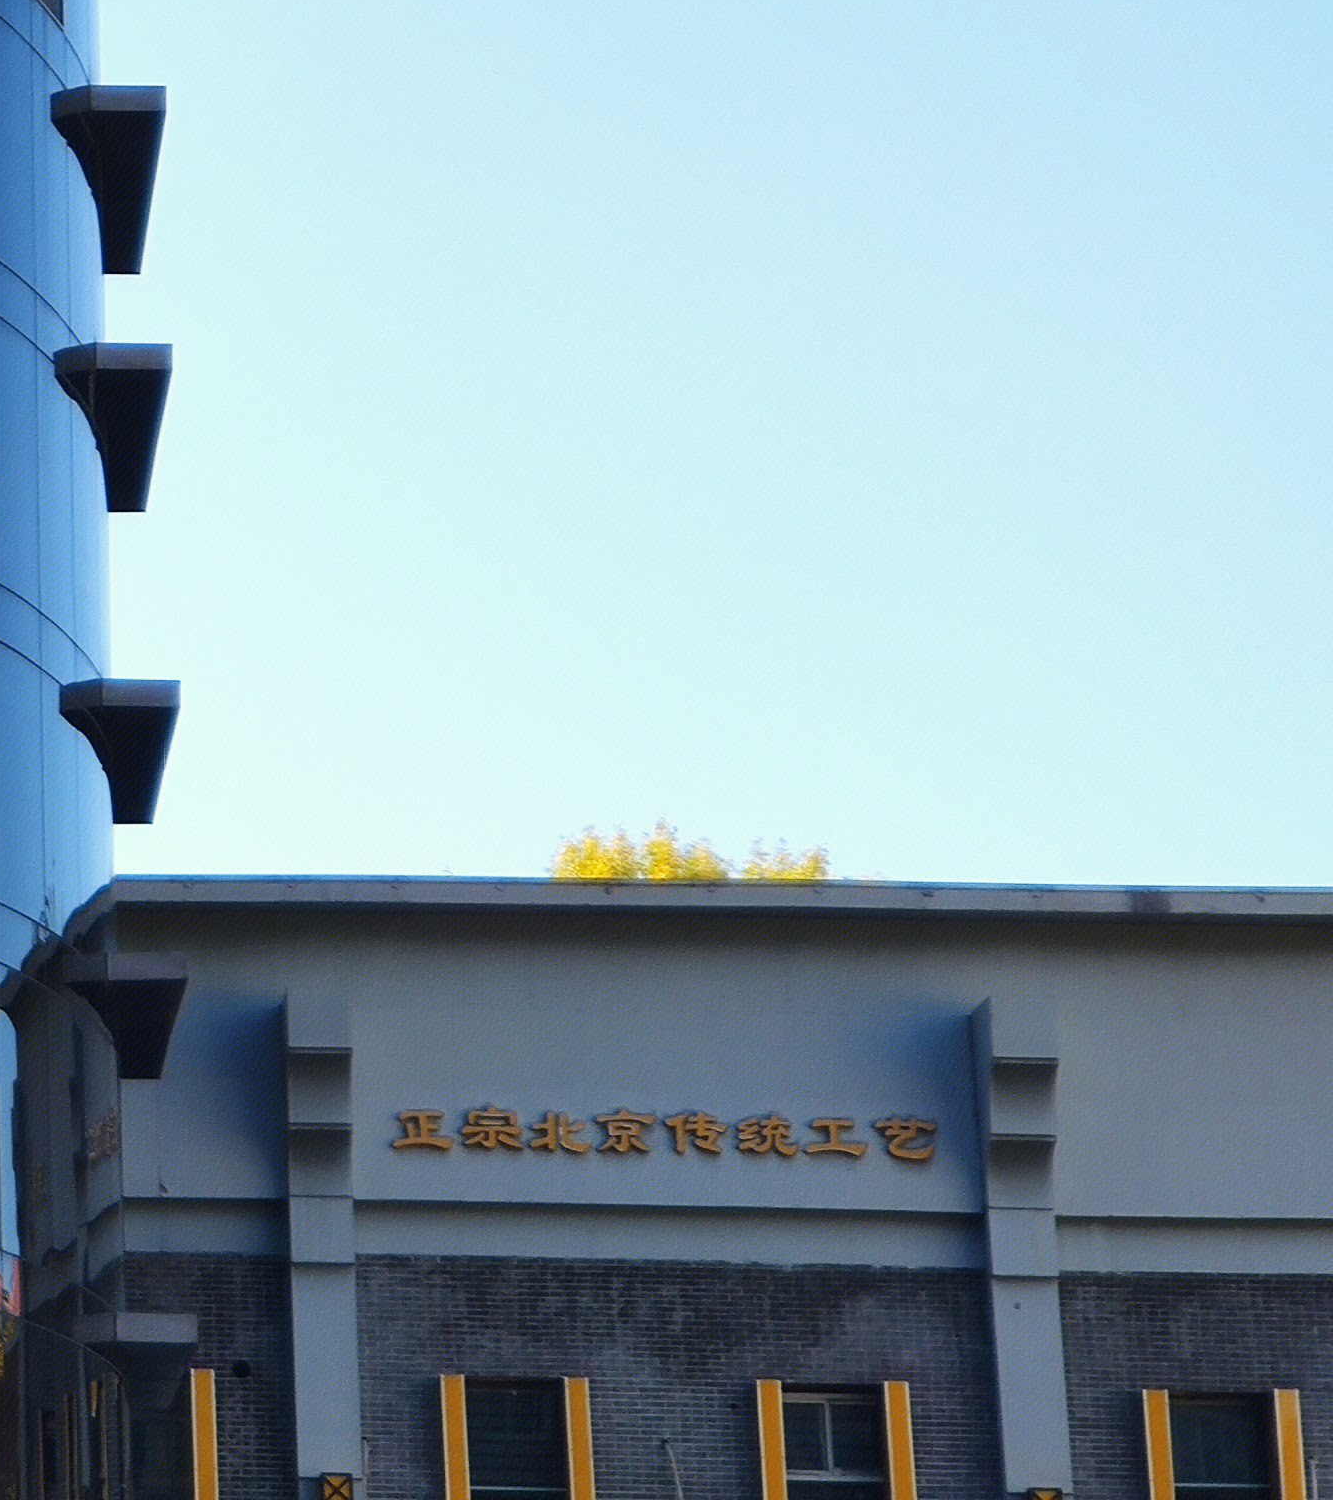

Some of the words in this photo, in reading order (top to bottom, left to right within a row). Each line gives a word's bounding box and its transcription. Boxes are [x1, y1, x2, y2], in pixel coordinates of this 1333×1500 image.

[392, 1105, 938, 1161] 正宗北京传统工艺
